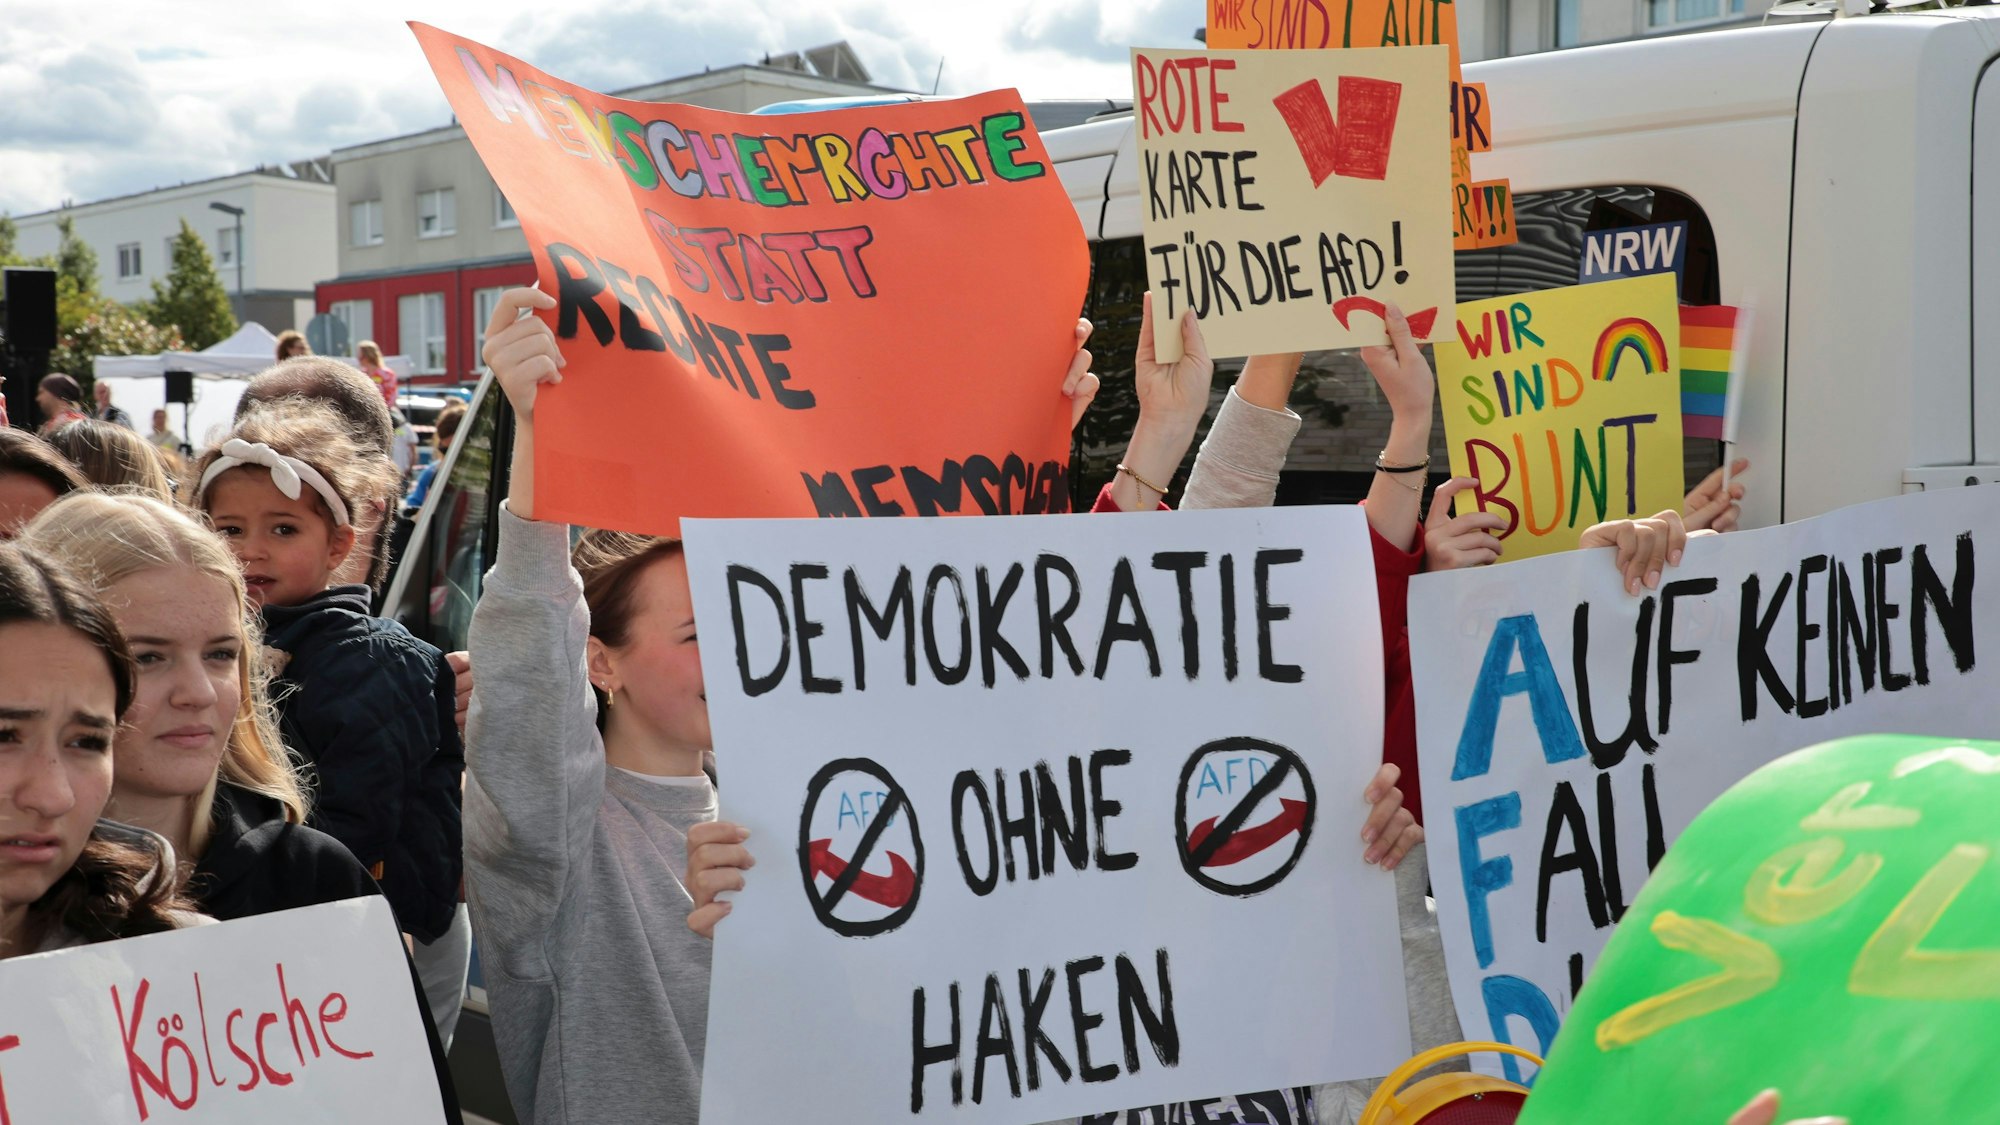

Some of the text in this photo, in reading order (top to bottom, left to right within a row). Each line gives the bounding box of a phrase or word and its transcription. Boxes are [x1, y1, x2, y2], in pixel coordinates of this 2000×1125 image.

[1214, 0, 1246, 32] WIR
[1248, 0, 1330, 49] SIND
[1136, 54, 1245, 140] ROTE
[1144, 150, 1264, 221] KARTE
[645, 208, 877, 304] STATT
[1150, 231, 1243, 320] FÜR
[1238, 234, 1313, 305] DIE
[1584, 226, 1682, 276] NRW
[545, 241, 816, 410] RECHTE
[1456, 302, 1545, 360] WIR
[1461, 358, 1584, 425] SIND
[1465, 413, 1658, 541] BUNT
[727, 548, 1305, 697] DEMOKRATIE
[1451, 531, 1976, 782] AUF KEINEN
[950, 748, 1139, 897] OHNE
[110, 962, 375, 1123] Kölsche
[911, 948, 1180, 1114] HAKEN
